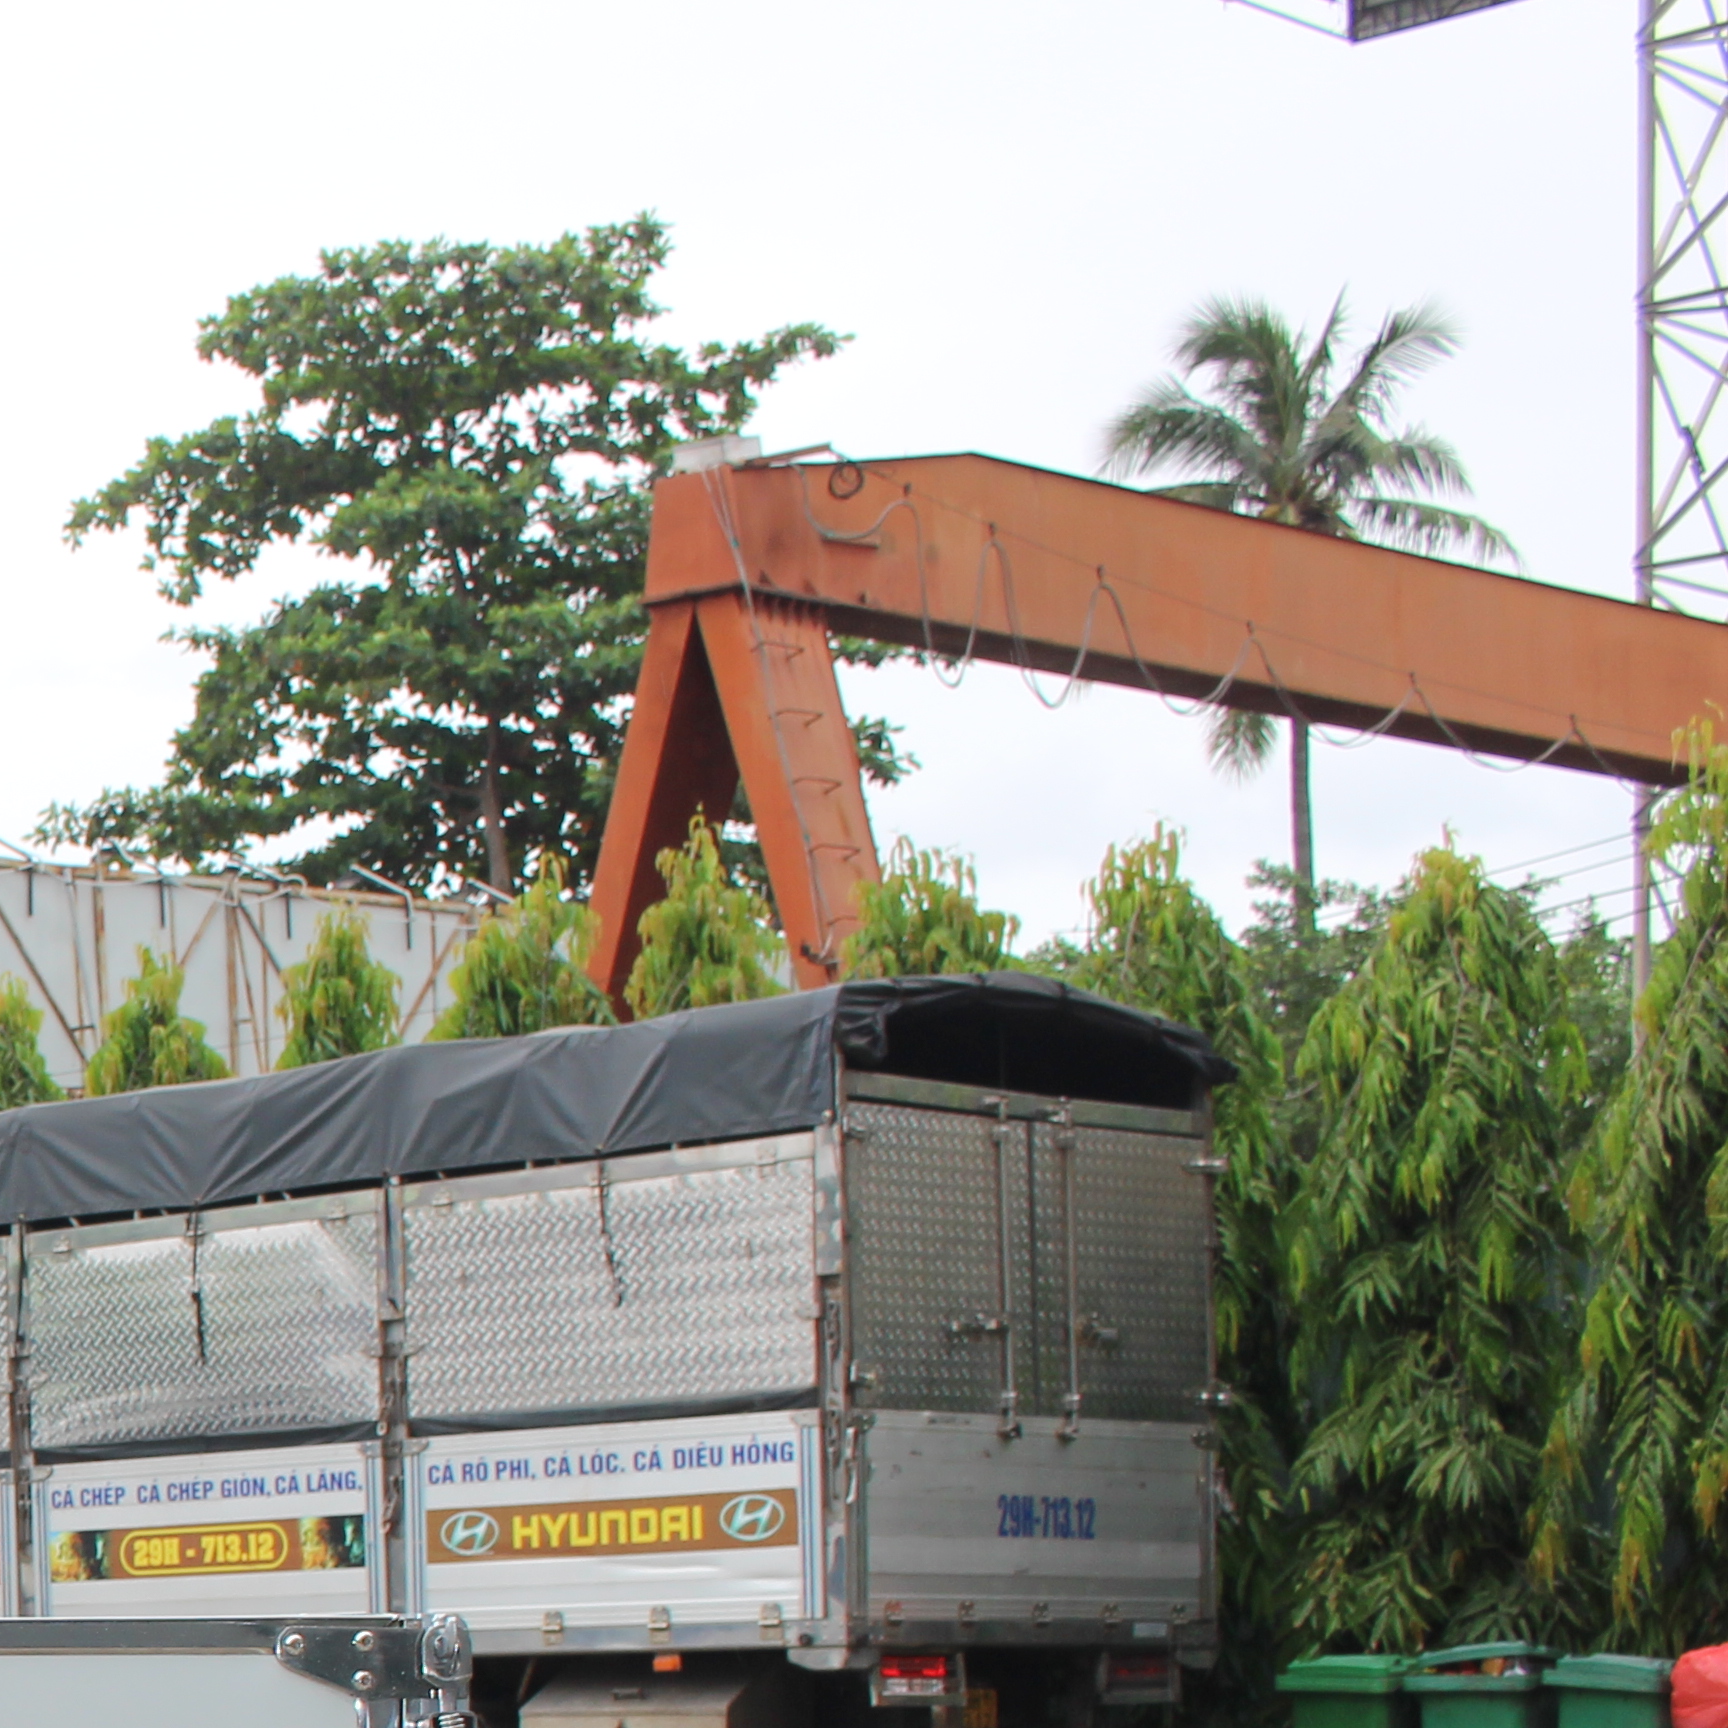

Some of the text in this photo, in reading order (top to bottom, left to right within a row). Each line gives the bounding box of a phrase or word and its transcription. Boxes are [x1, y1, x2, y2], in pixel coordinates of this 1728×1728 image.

[428, 1459, 455, 1485] CÁ
[544, 1450, 571, 1477] CÁ
[633, 1444, 663, 1471] CÁ
[51, 1484, 74, 1509] CÁ
[80, 1481, 126, 1507] CHÉP
[137, 1478, 161, 1504] CÁ
[167, 1476, 214, 1502] CHÉP
[275, 1469, 300, 1495] CÁ
[511, 1504, 703, 1550] HYUNDAI
[997, 1494, 1095, 1540] 29H-713.12
[133, 1537, 180, 1567] 29H
[200, 1532, 275, 1564] 713.12
